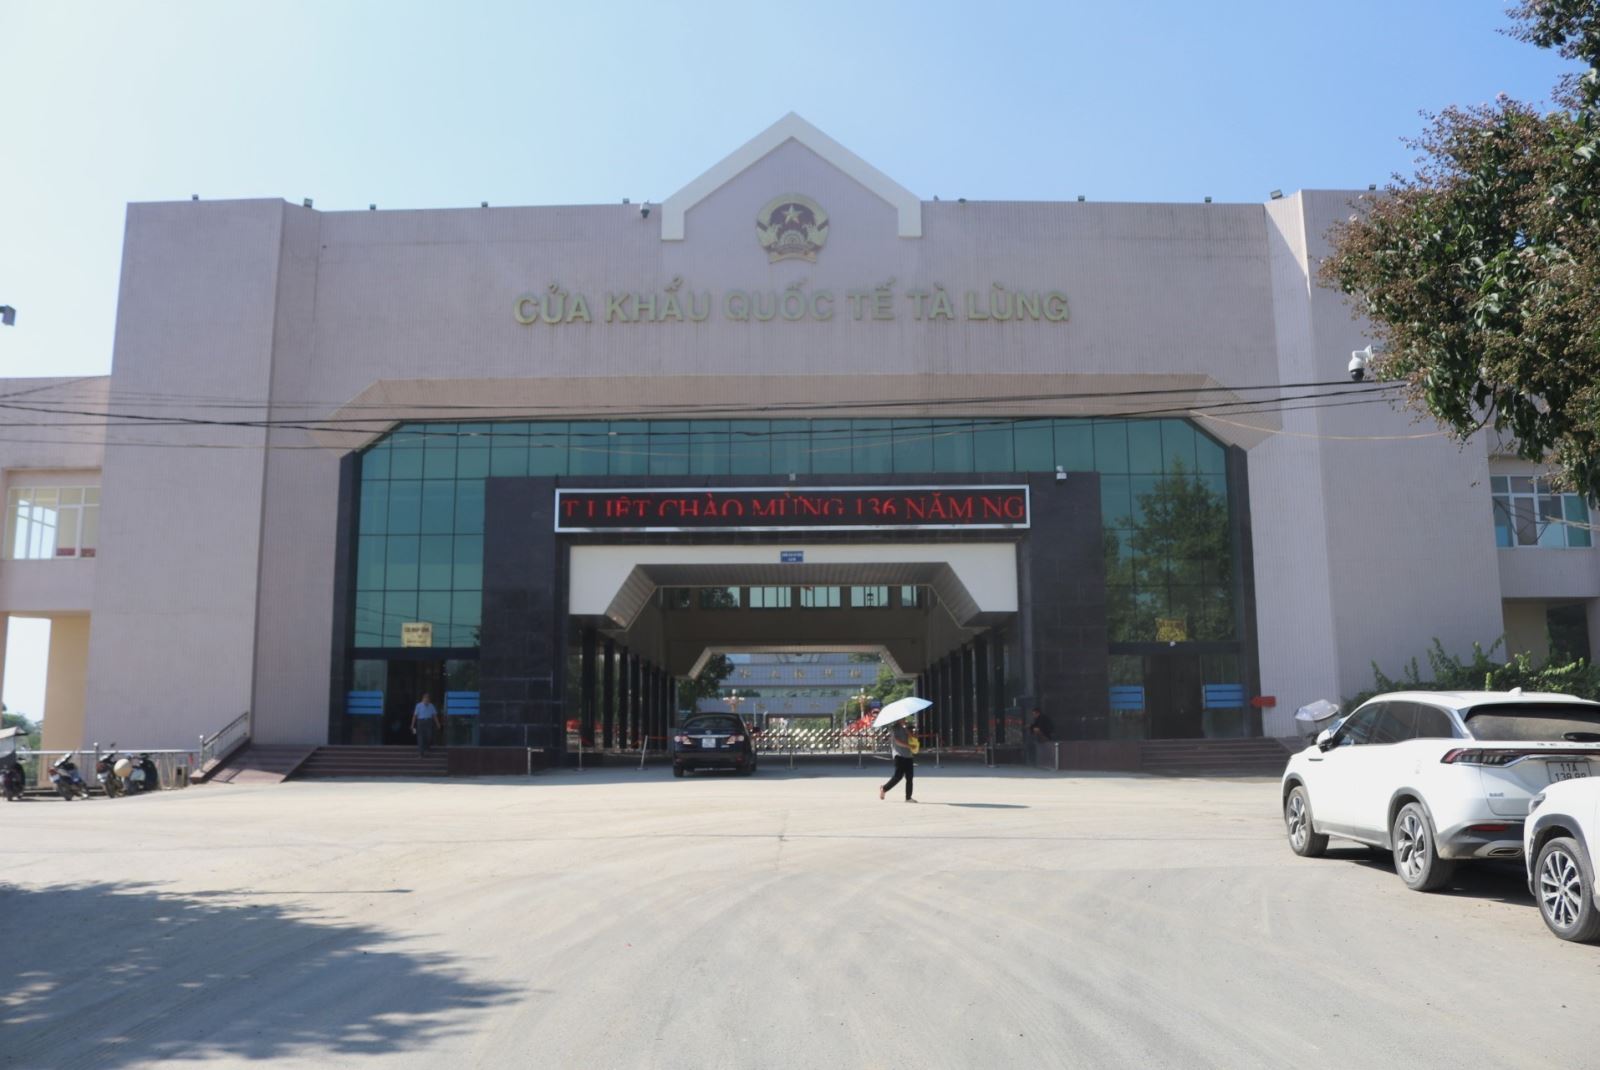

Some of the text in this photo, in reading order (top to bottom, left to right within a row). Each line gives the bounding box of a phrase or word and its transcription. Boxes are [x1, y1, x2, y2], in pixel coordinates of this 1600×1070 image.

[513, 276, 1070, 324] CỬA KHẨU QUỐC TẾ TÀ LÙNG
[905, 492, 974, 519] NĂM
[980, 497, 1025, 519] NG
